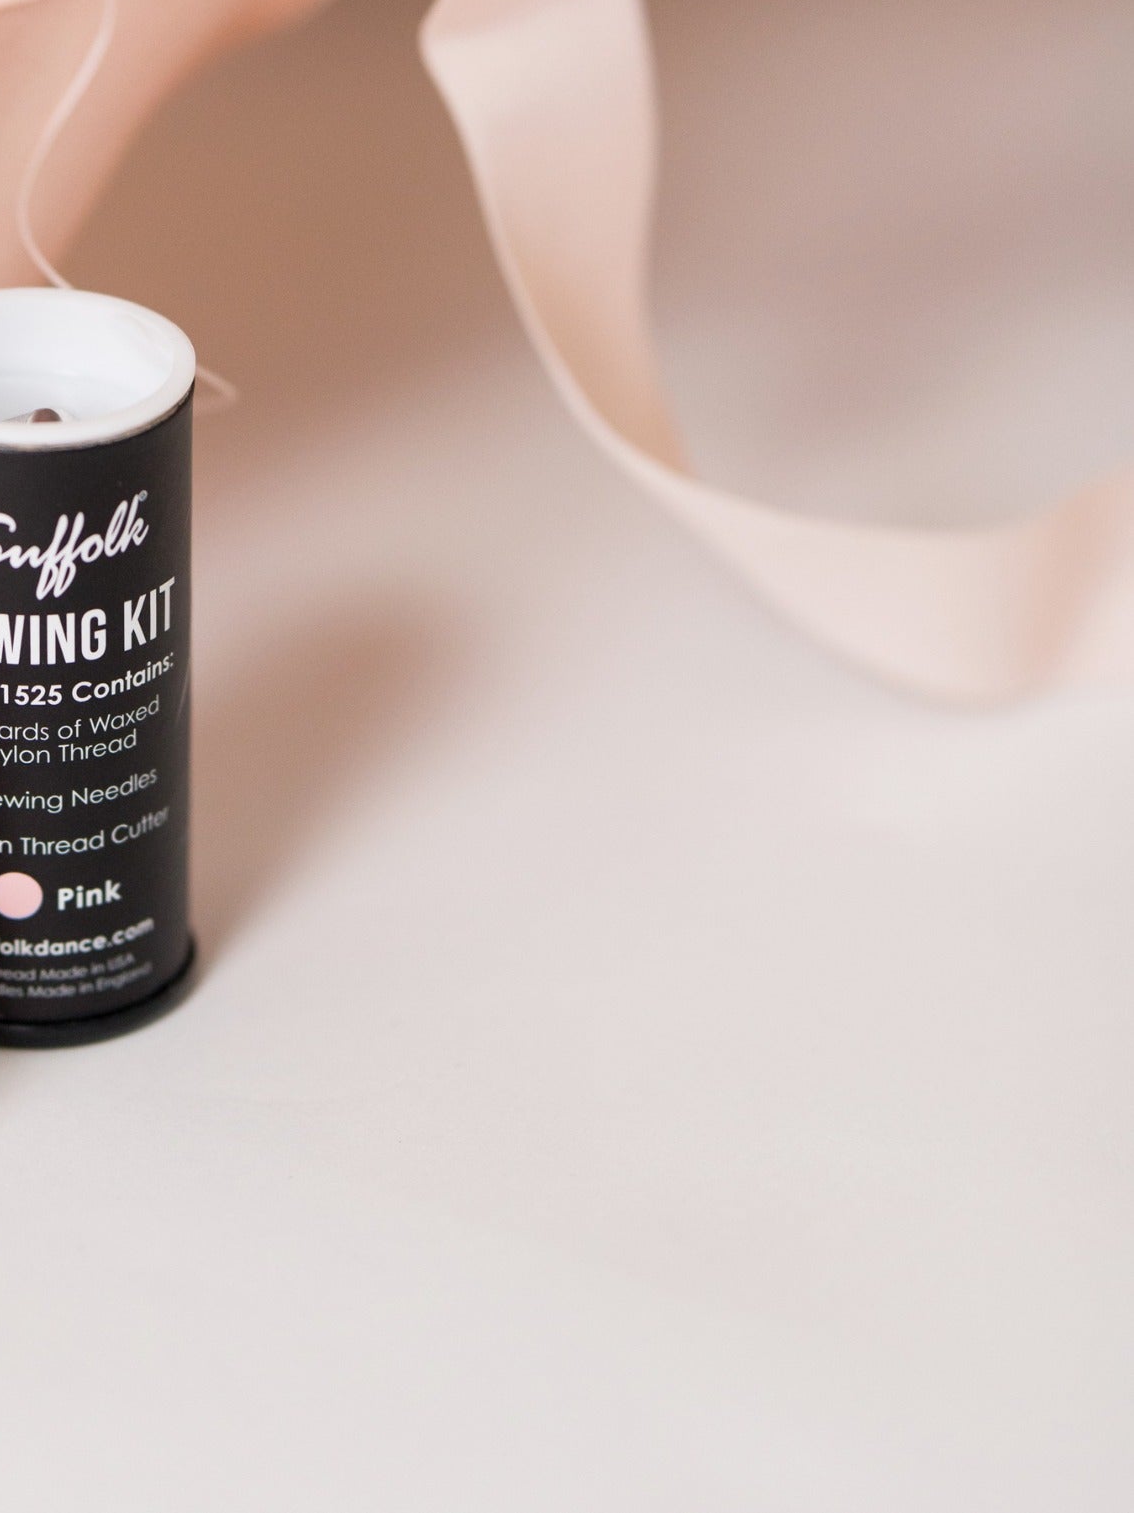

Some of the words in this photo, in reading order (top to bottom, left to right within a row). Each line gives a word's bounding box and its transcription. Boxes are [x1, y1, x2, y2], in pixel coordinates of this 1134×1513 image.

[124, 577, 175, 651] KIT
[0, 684, 63, 706] 1525
[72, 652, 174, 701] Contains:
[58, 719, 81, 740] of
[89, 694, 159, 731] Waxed
[58, 729, 137, 762] Thread
[72, 769, 158, 807] Needles
[20, 830, 104, 855] Thread
[111, 807, 169, 845] Cutter
[57, 880, 122, 911] Pink
